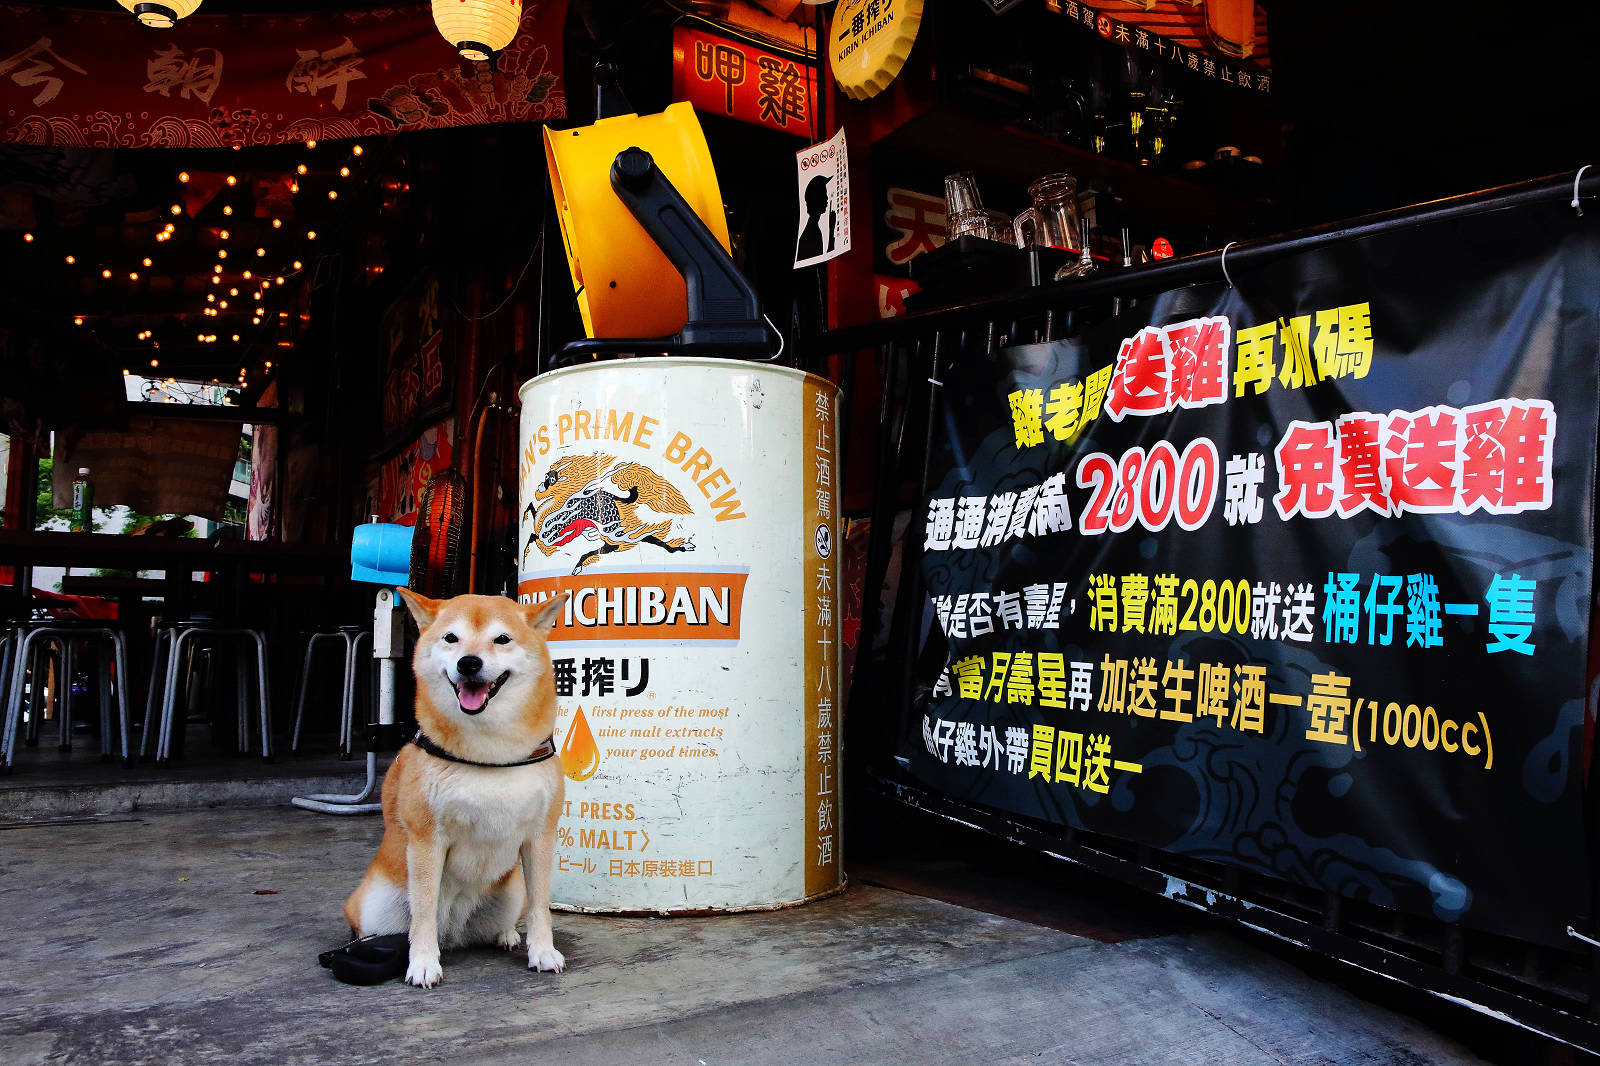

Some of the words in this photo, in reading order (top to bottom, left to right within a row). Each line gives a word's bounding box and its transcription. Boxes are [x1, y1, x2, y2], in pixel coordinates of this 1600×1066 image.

[838, 39, 859, 63] KIRIN
[861, 10, 894, 44] ICHIBAN
[695, 40, 806, 127] 呷雞
[558, 409, 660, 449] PRIME
[662, 431, 747, 522] BREW
[815, 390, 831, 519] 禁止酒駕
[564, 586, 730, 627] ICHIBAN
[592, 706, 617, 718] first
[620, 707, 654, 720] press
[658, 705, 672, 718] of
[675, 706, 694, 718] the
[698, 706, 729, 718] most
[598, 726, 627, 738] uine
[630, 726, 661, 738] malt
[665, 726, 723, 738] extracts
[816, 562, 833, 867] 未滿十八歲禁止飲酒
[605, 747, 637, 760] your
[640, 746, 677, 760] good
[580, 802, 635, 820] PRESS
[609, 859, 713, 878] 日本原裝進口
